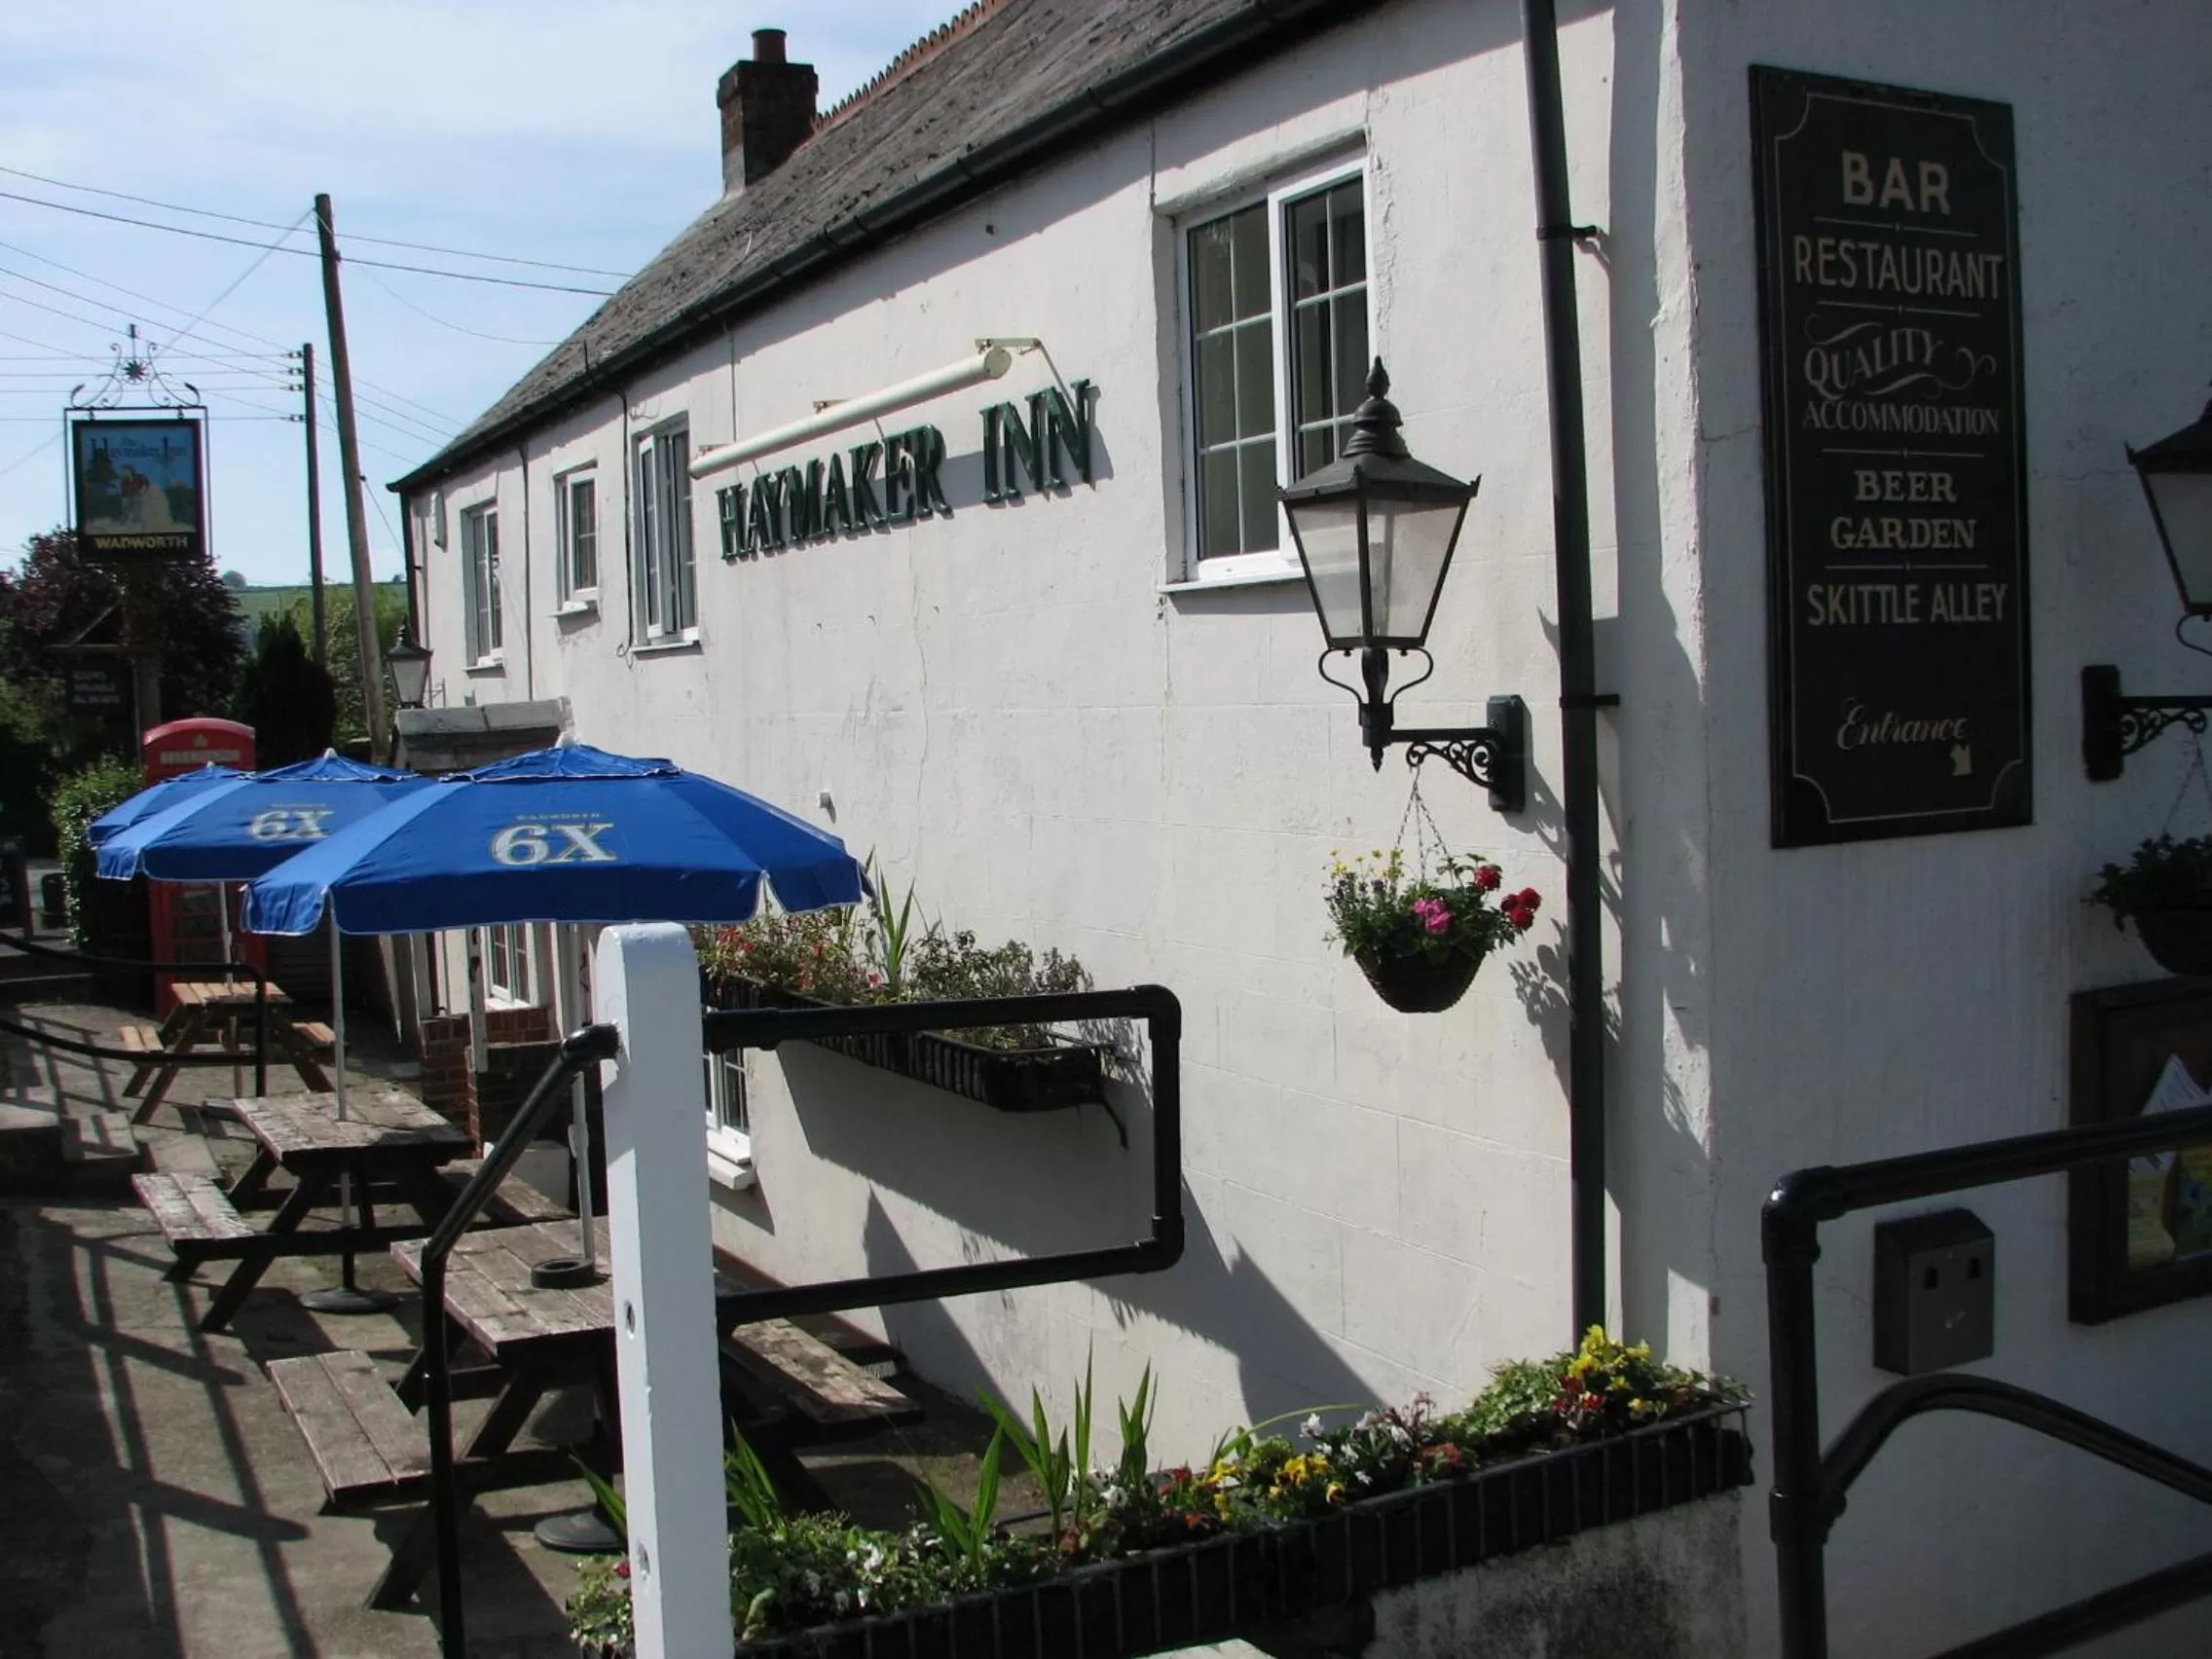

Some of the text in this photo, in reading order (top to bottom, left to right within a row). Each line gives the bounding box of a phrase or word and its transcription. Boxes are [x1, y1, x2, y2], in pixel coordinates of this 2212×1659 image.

[1842, 149, 1951, 214] BAR
[1793, 235, 2004, 300] RESTAURANT
[1804, 327, 1943, 401] QUALITY
[1802, 400, 2000, 435] ACCOMMODATION
[716, 378, 1101, 563] HAYMAKER INN
[1854, 470, 1958, 502] BEER
[93, 535, 188, 550] WADWORTH
[1830, 517, 1976, 549] GARDEN
[1807, 583, 2009, 626] SKITTLE ALLEY
[1837, 697, 1970, 751] Entrance
[250, 810, 335, 841] 6X
[491, 823, 618, 866] 6X
